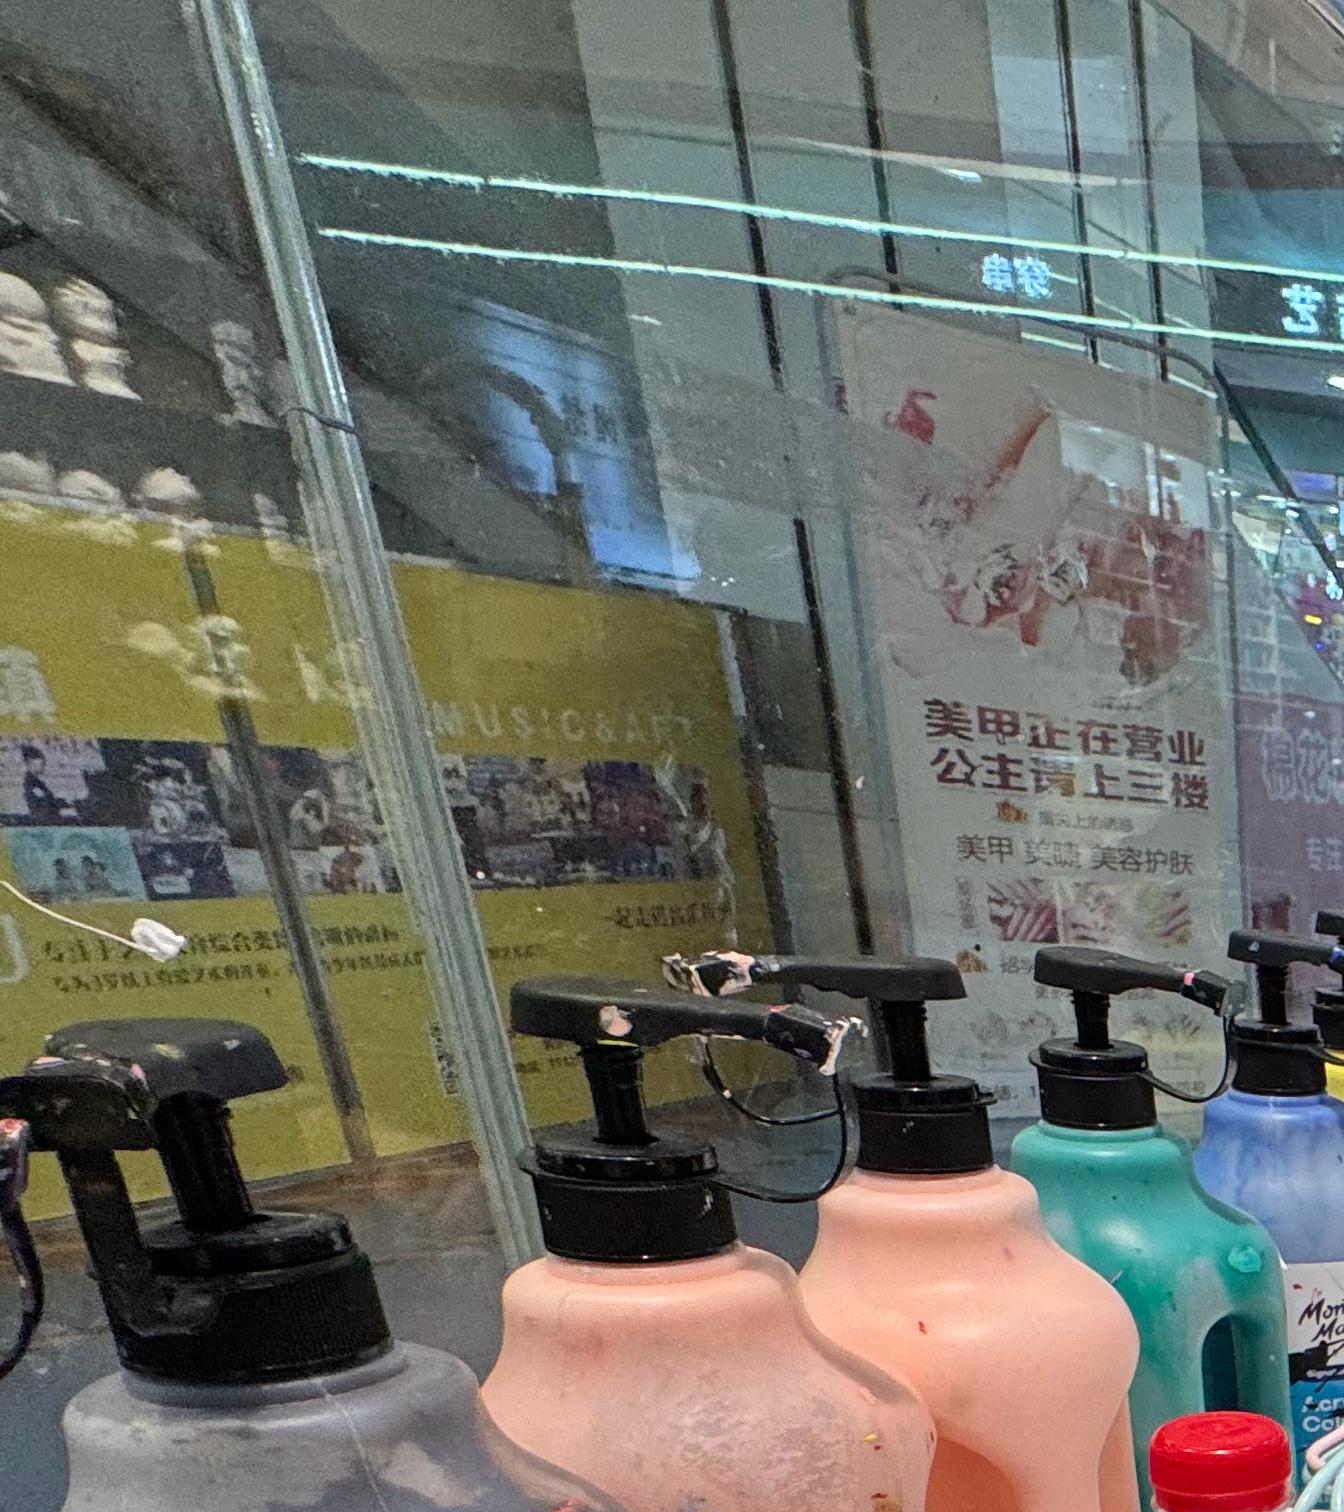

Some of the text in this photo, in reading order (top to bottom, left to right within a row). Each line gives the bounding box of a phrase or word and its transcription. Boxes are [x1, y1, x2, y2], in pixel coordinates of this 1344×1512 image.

[924, 698, 1206, 767] 美甲正在营业
[930, 746, 1210, 811] 公主请上三楼
[956, 834, 1014, 865] 美甲
[1090, 843, 1195, 876] 美容护肤
